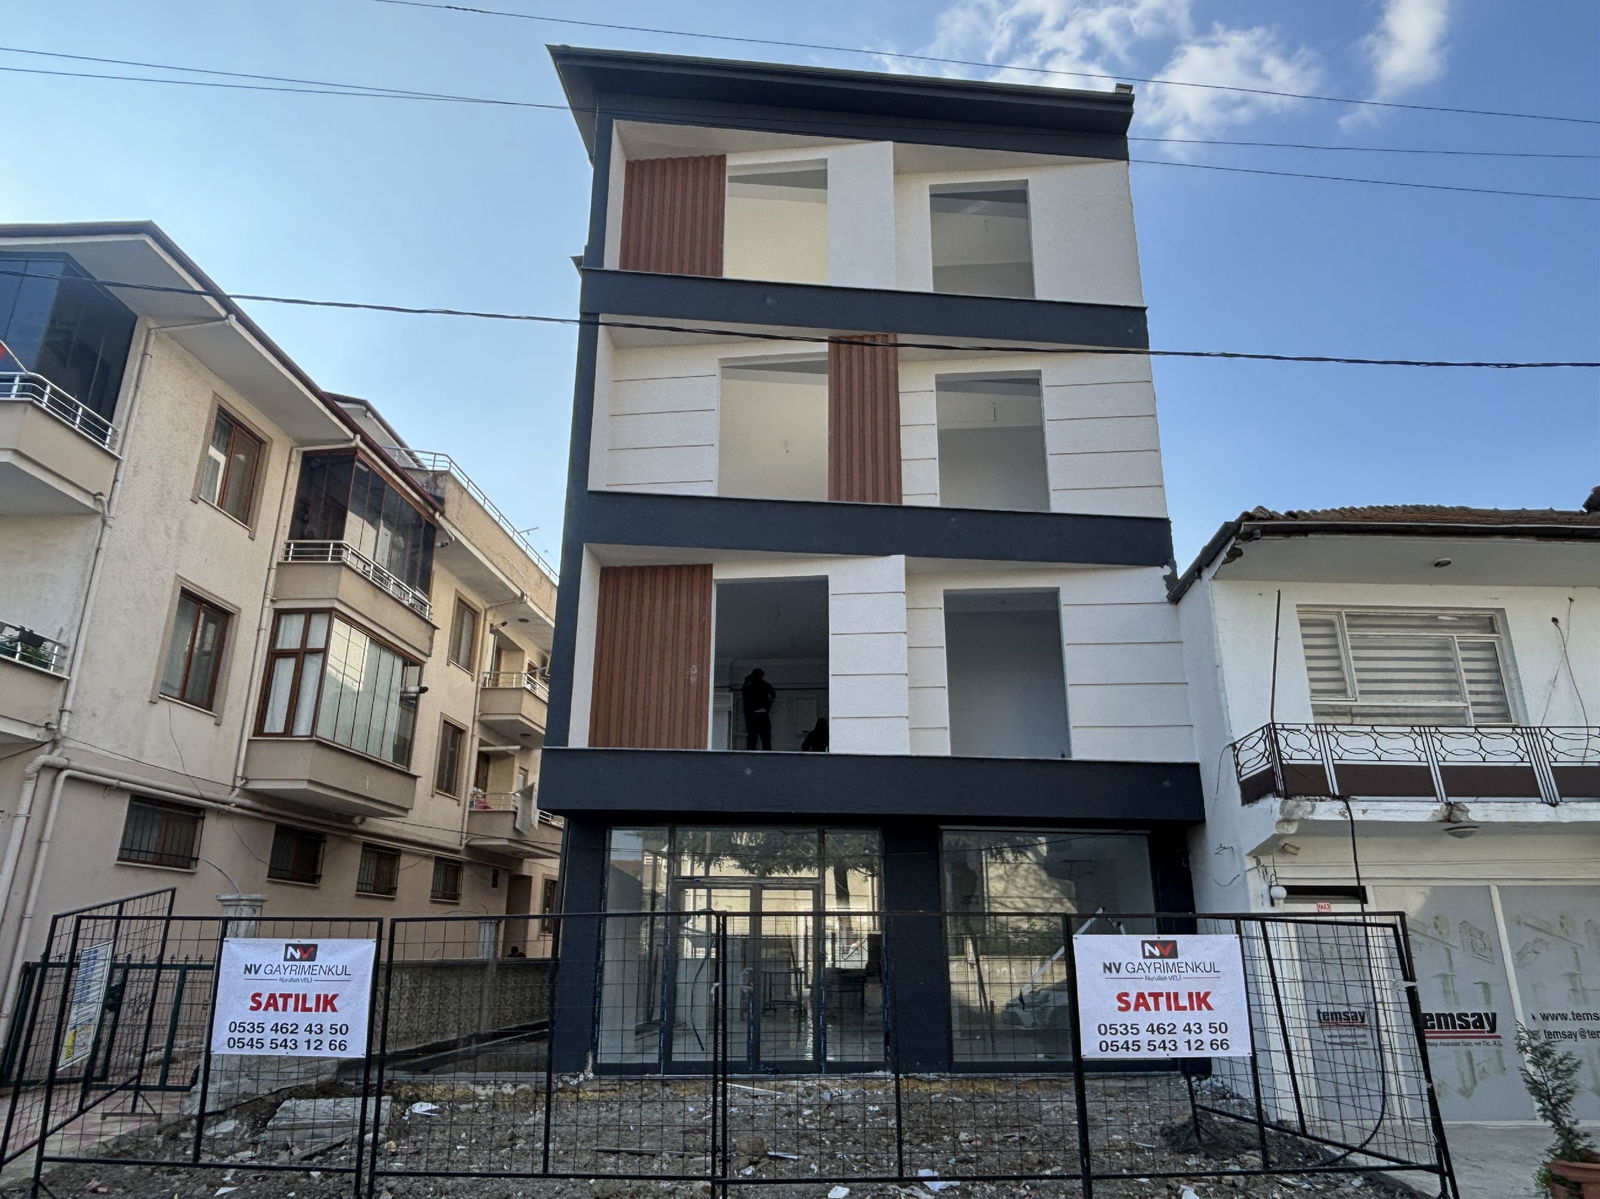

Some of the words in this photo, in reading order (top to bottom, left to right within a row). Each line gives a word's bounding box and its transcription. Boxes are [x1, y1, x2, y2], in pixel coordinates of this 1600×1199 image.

[286, 945, 315, 960] NV
[1144, 942, 1174, 957] NV
[243, 964, 262, 975] NV
[263, 962, 352, 976] GAYRİMENKUL
[1102, 962, 1122, 974] NV
[1125, 959, 1221, 973] GAYRİMENKUL
[249, 992, 339, 1013] SATILIK
[1116, 991, 1214, 1012] SATILIK
[1316, 1008, 1366, 1023] temsay
[1421, 1012, 1497, 1034] emsay
[1539, 1010, 1600, 1021] www.tems
[228, 1021, 265, 1034] 0535
[270, 1022, 299, 1034] 462
[304, 1023, 324, 1035] 43
[329, 1023, 349, 1036] 50
[1097, 1023, 1140, 1036] 0535
[1145, 1023, 1177, 1035] 462
[1182, 1022, 1202, 1034] 43
[1208, 1022, 1228, 1034] 50
[227, 1037, 264, 1049] 0545
[269, 1038, 298, 1050] 543
[304, 1039, 323, 1051] 12
[328, 1039, 348, 1051] 66
[1099, 1039, 1141, 1052] 0545
[1147, 1039, 1178, 1052] 543
[1184, 1039, 1204, 1051] 12
[1209, 1038, 1230, 1051] 66
